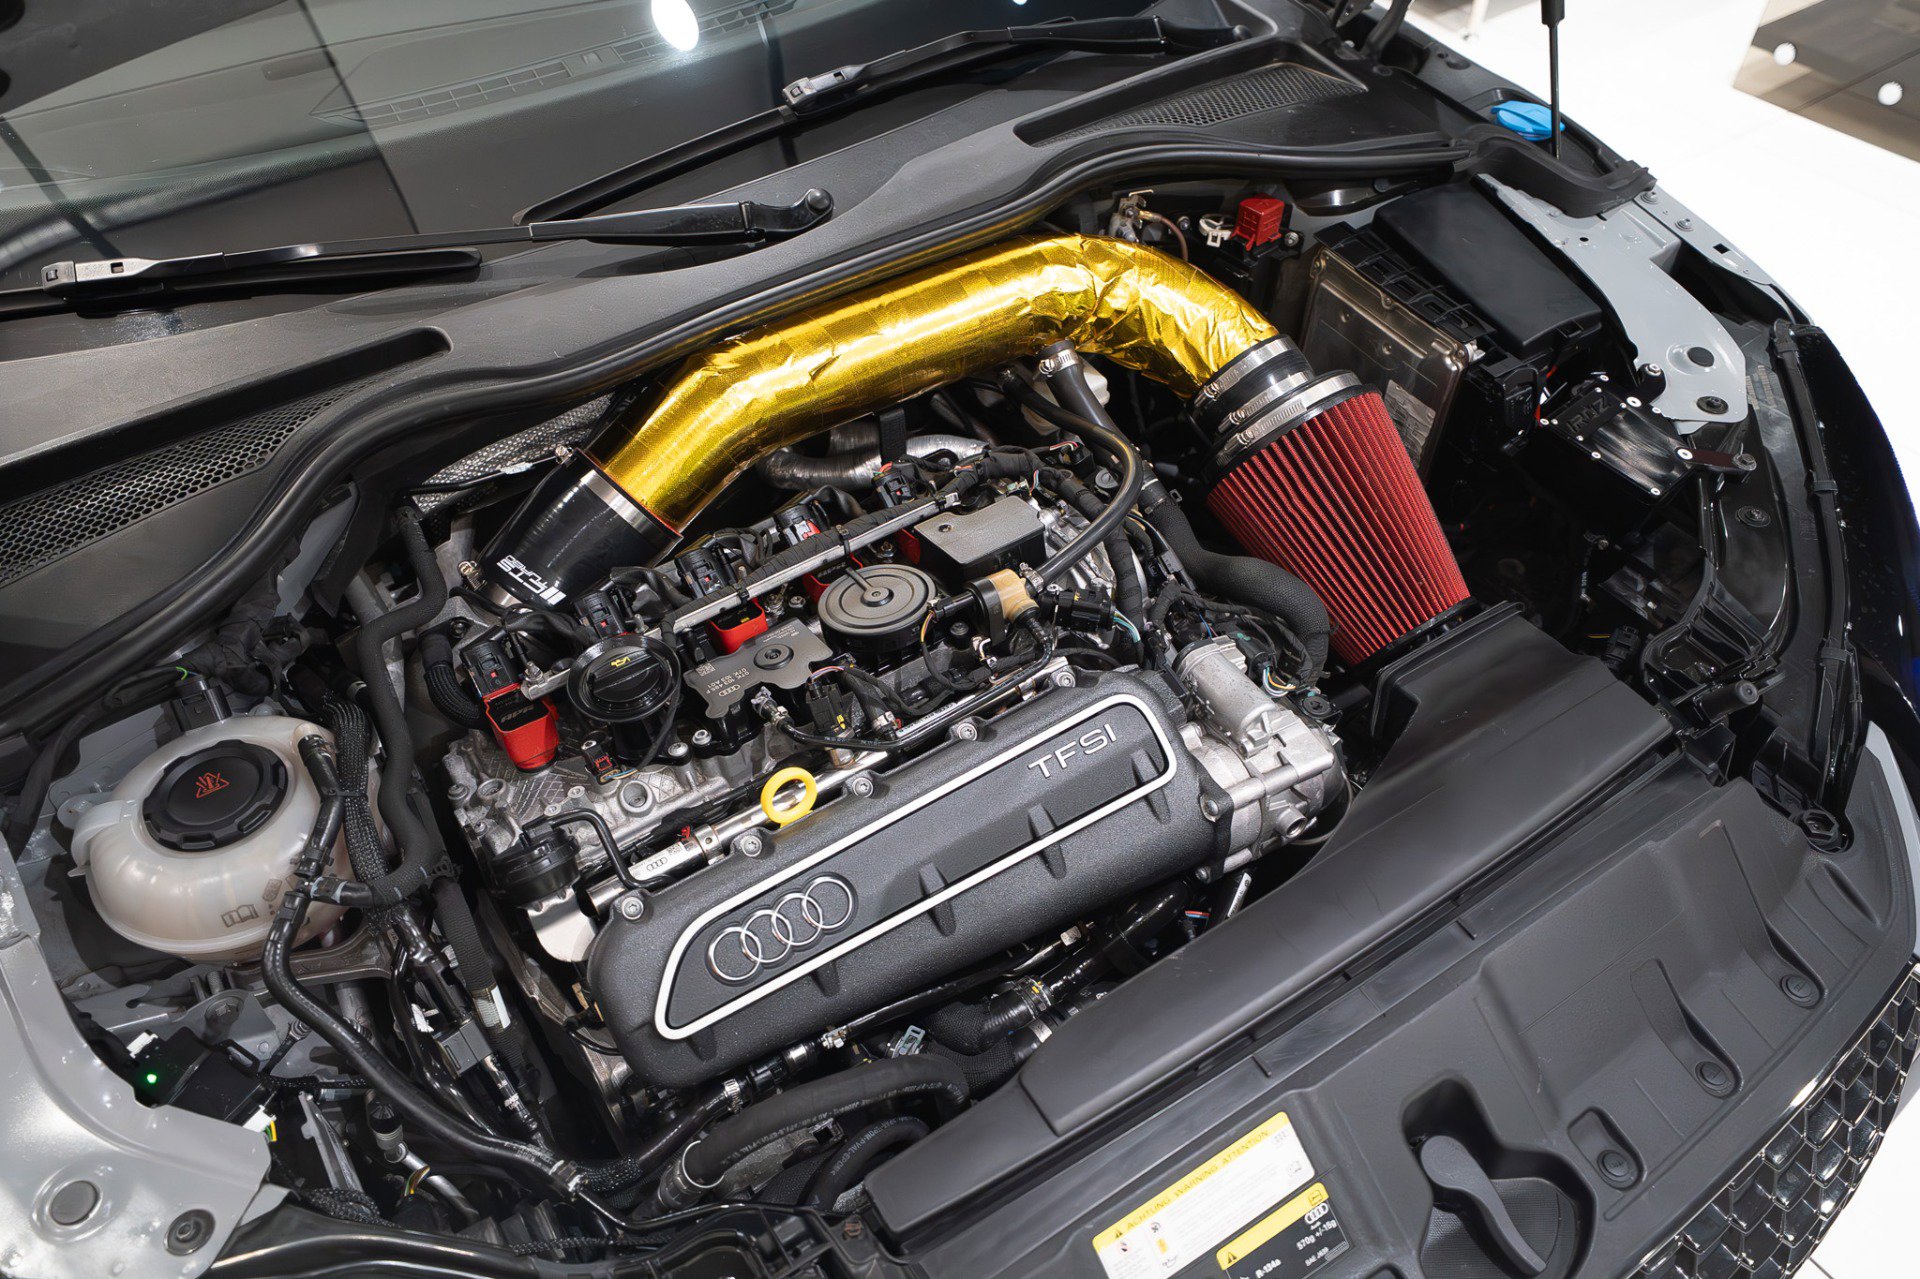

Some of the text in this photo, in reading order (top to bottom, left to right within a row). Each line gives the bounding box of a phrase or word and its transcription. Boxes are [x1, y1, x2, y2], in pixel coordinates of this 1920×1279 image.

[496, 557, 547, 594] CTS
[504, 554, 548, 588] TURBO
[1027, 723, 1117, 778] TFSI
[1174, 1163, 1220, 1198] WARNING
[1221, 1129, 1270, 1165] ATTENTION
